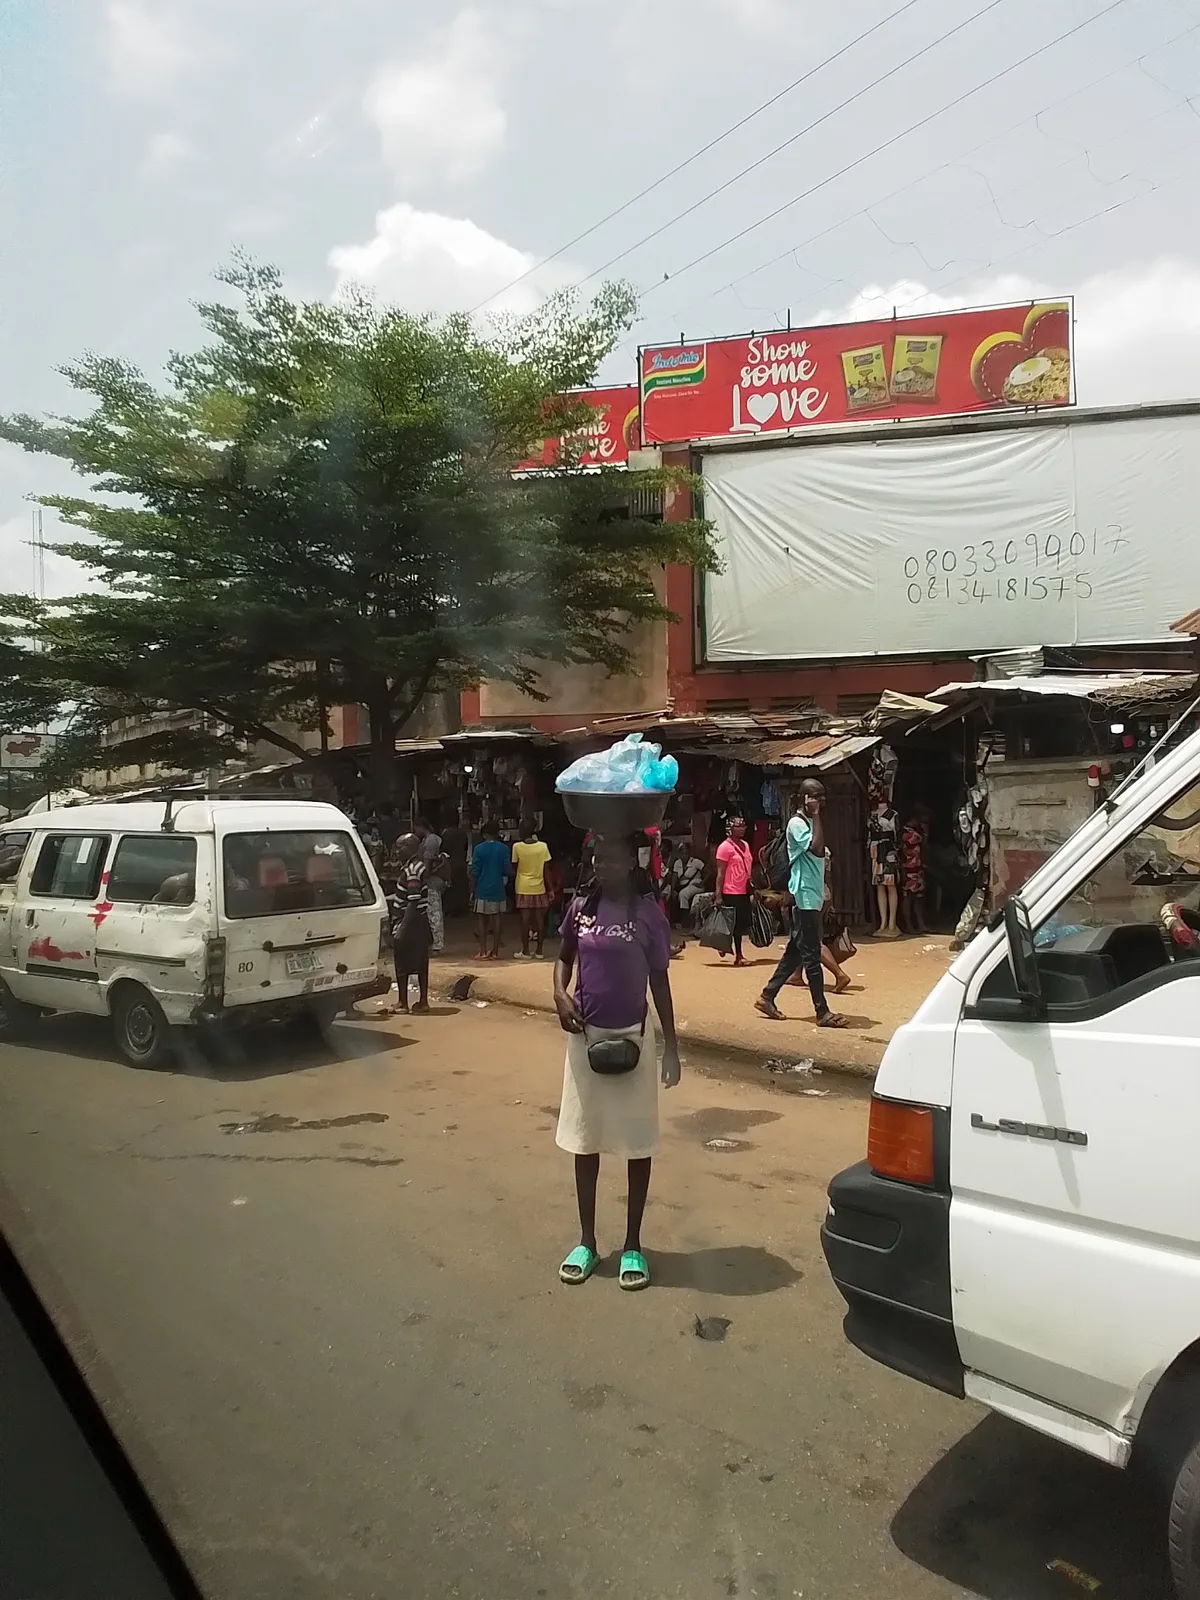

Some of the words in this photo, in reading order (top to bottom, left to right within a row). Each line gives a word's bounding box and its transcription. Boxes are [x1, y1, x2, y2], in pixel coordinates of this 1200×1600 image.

[651, 351, 699, 369] Indomie
[748, 337, 811, 364] Show
[740, 360, 817, 388] some
[970, 1112, 1087, 1146] L300
